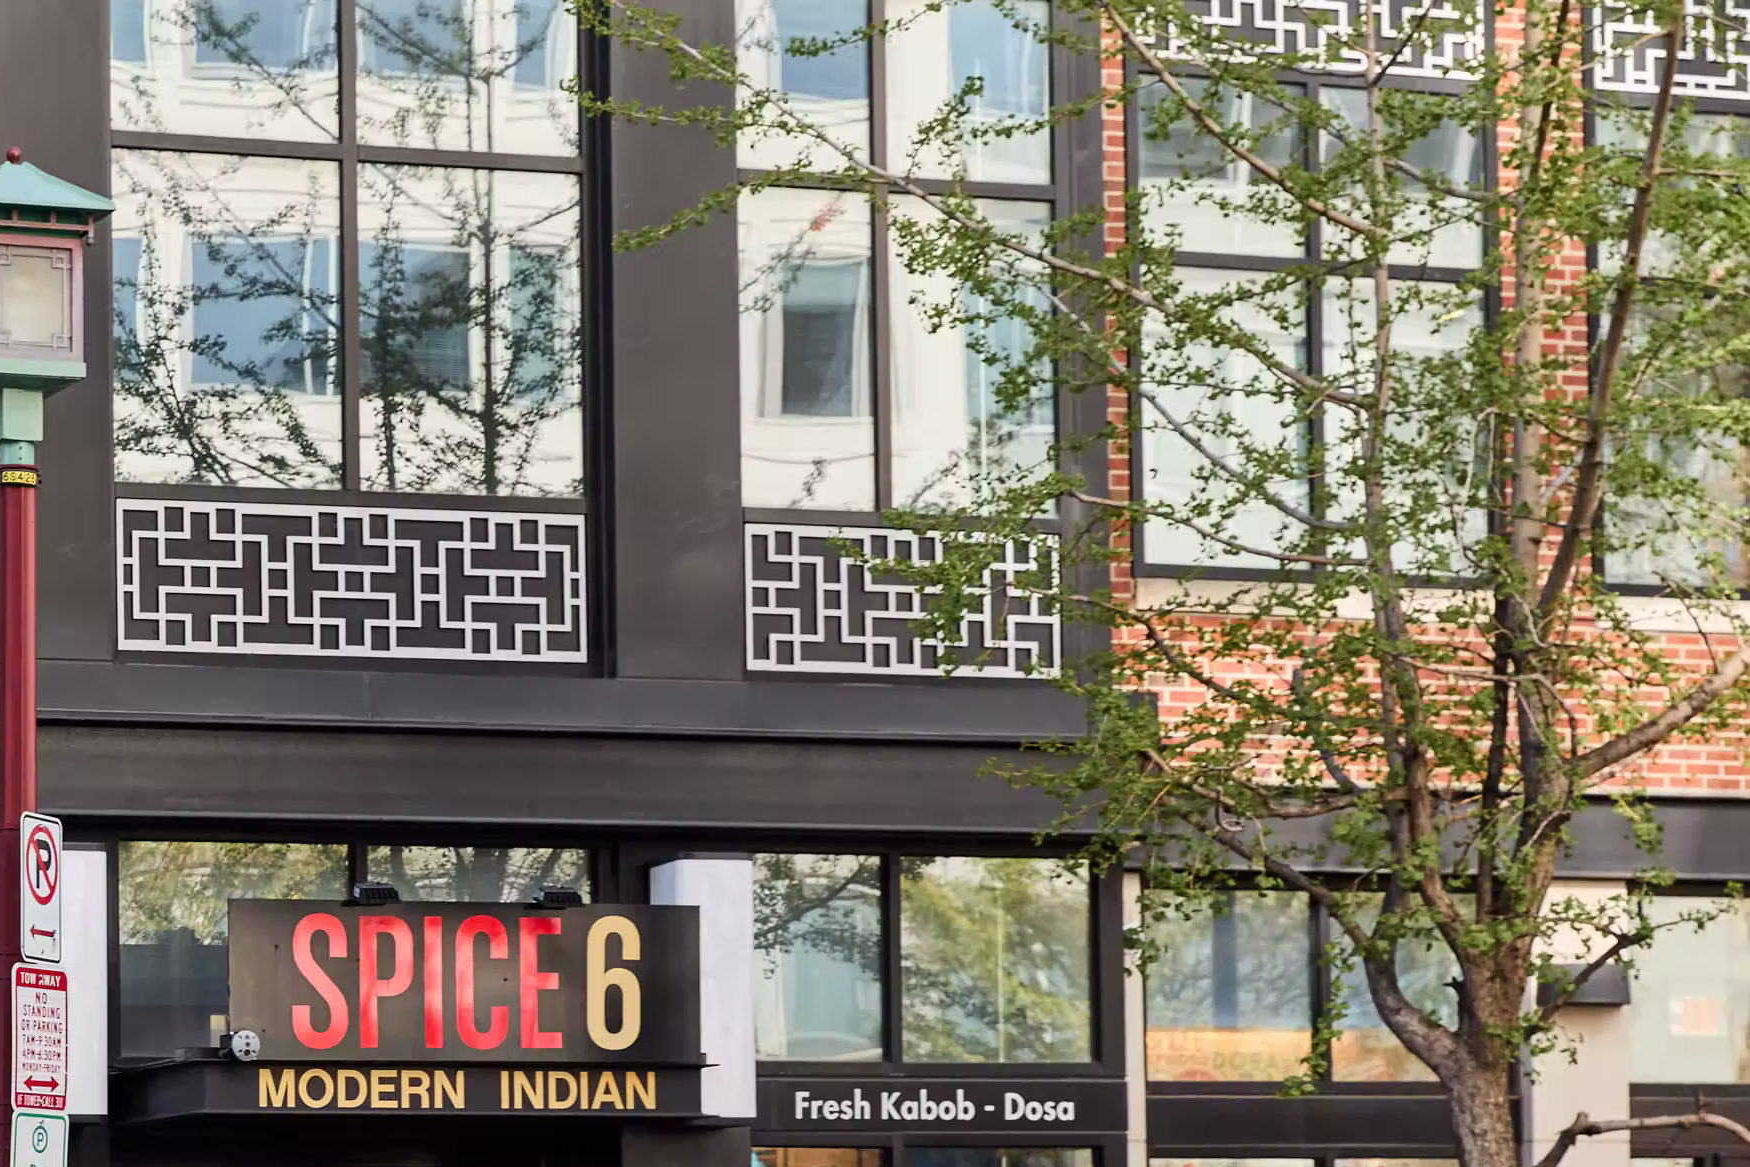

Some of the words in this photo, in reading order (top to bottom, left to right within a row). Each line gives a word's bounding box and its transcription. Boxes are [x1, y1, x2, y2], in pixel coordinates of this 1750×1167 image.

[20, 971, 36, 985] TOW
[38, 974, 61, 987] AWAY
[292, 913, 563, 1050] SPICE
[586, 915, 641, 1051] 6
[35, 992, 48, 1005] NO
[22, 1004, 61, 1020] STANDING
[21, 1019, 30, 1031] OR
[33, 1020, 63, 1035] PARKING
[258, 1068, 465, 1110] MODERN
[500, 1070, 657, 1110] INDIAN
[794, 1088, 872, 1120] Fresh
[880, 1088, 976, 1121] Kabob
[1004, 1092, 1076, 1122] Dosa
